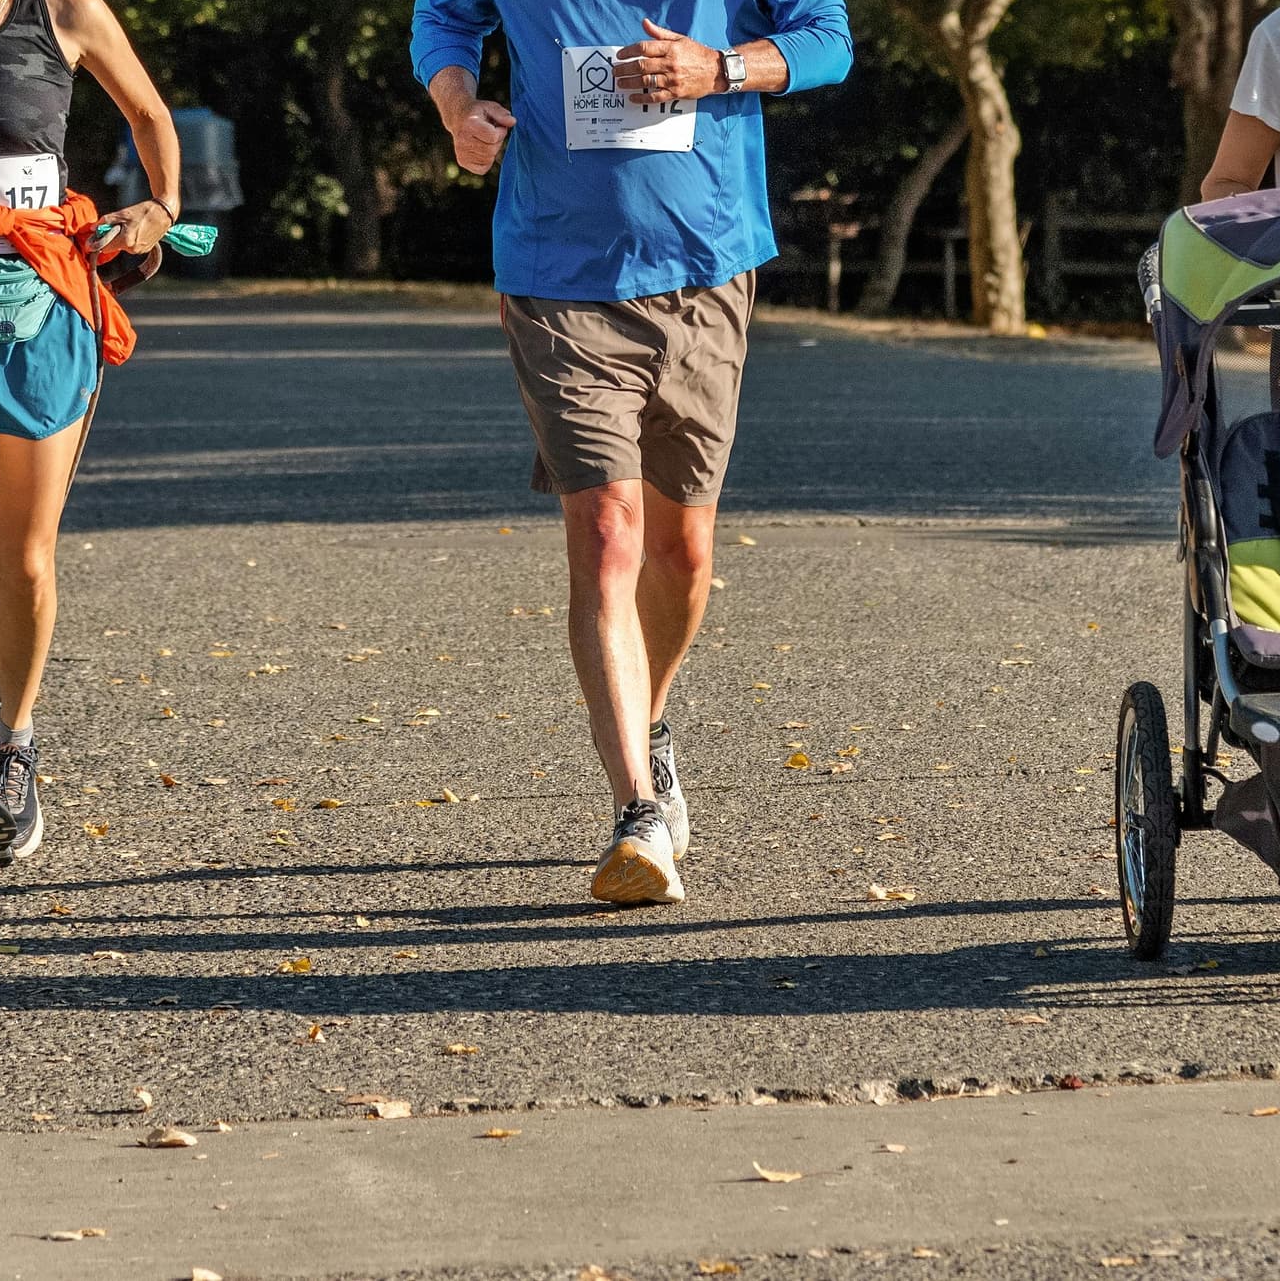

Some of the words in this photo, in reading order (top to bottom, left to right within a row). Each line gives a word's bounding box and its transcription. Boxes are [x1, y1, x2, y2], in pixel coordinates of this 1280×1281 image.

[574, 99, 599, 109] HOME
[603, 98, 625, 108] RUN
[5, 186, 48, 209] 157
